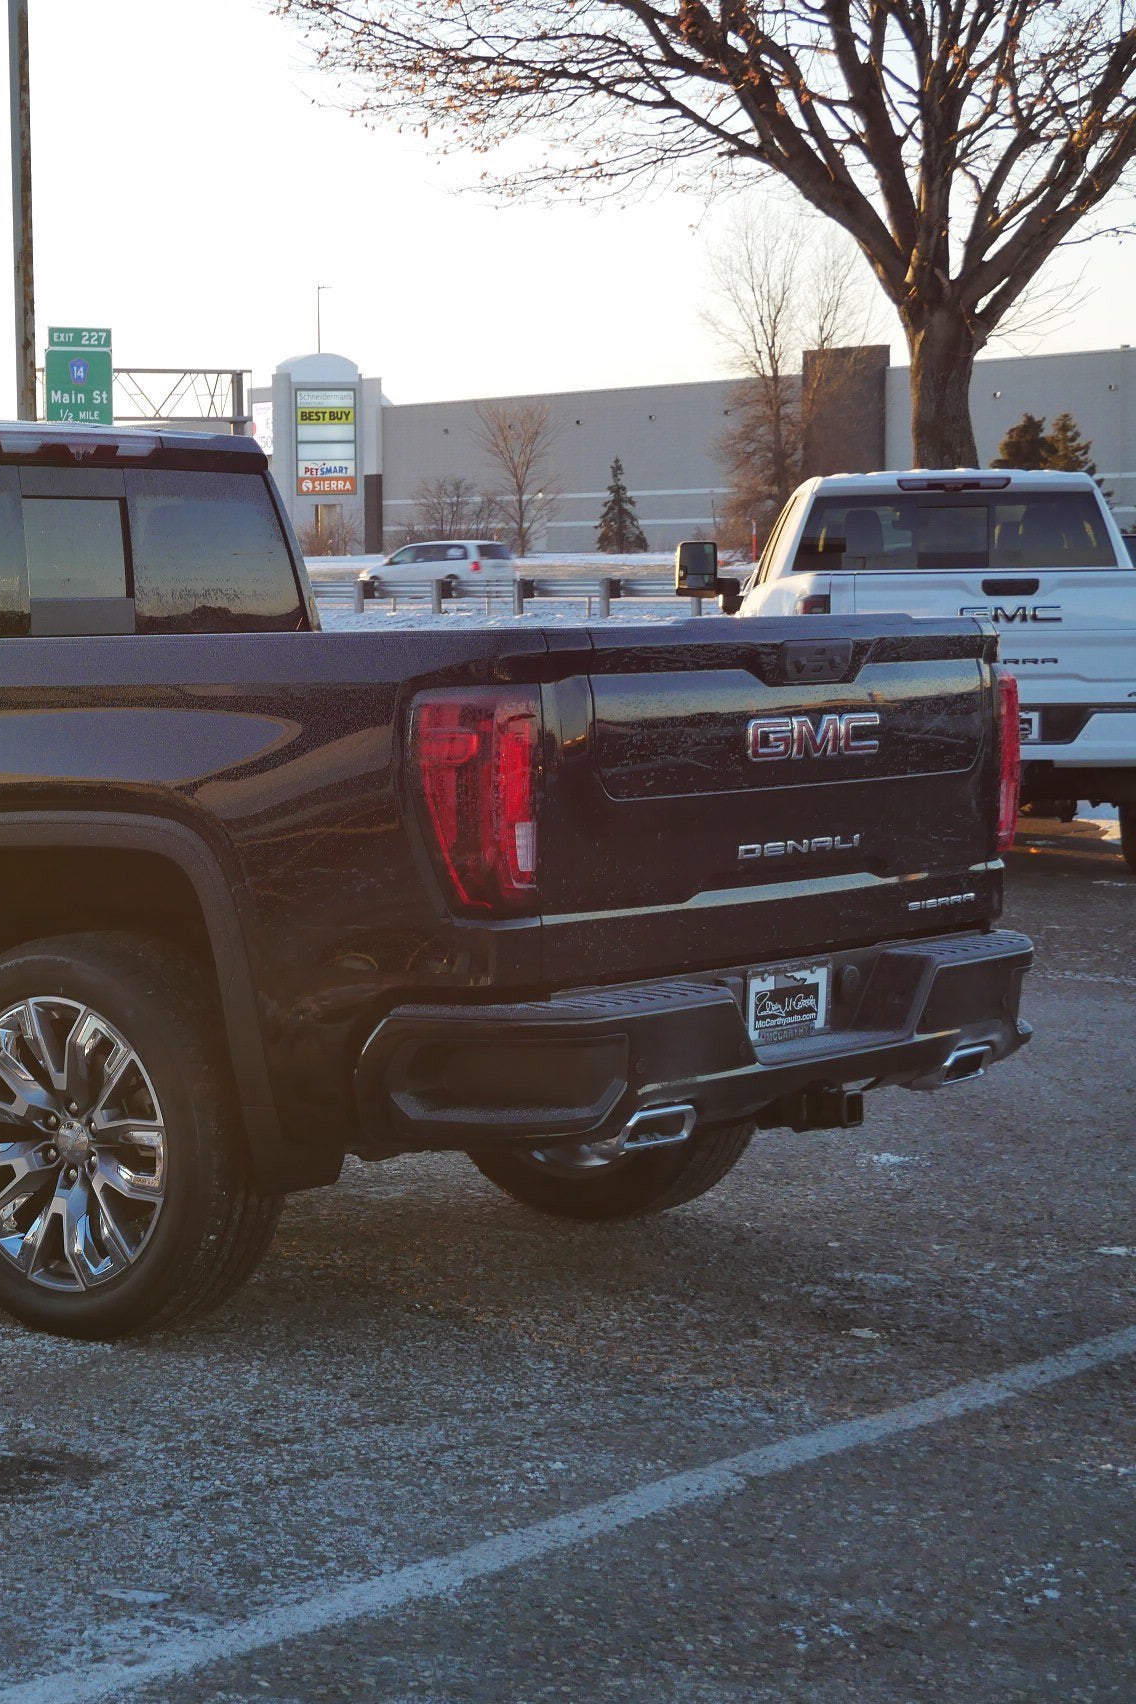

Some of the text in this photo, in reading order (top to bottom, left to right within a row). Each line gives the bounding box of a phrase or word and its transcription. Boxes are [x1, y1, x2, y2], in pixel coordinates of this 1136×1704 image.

[53, 332, 106, 345] EXIT 227
[73, 366, 84, 379] 14
[51, 390, 108, 404] Main St
[79, 411, 100, 420] MILE
[300, 410, 351, 421] BEST BUY
[314, 480, 352, 491] SIERRA
[959, 606, 1062, 624] GMC
[1002, 657, 1058, 665] RRA
[747, 712, 880, 762] GMC
[737, 834, 860, 860] DENALI
[908, 892, 975, 911] SIERRA
[755, 1012, 817, 1029] McCarthyauto.com
